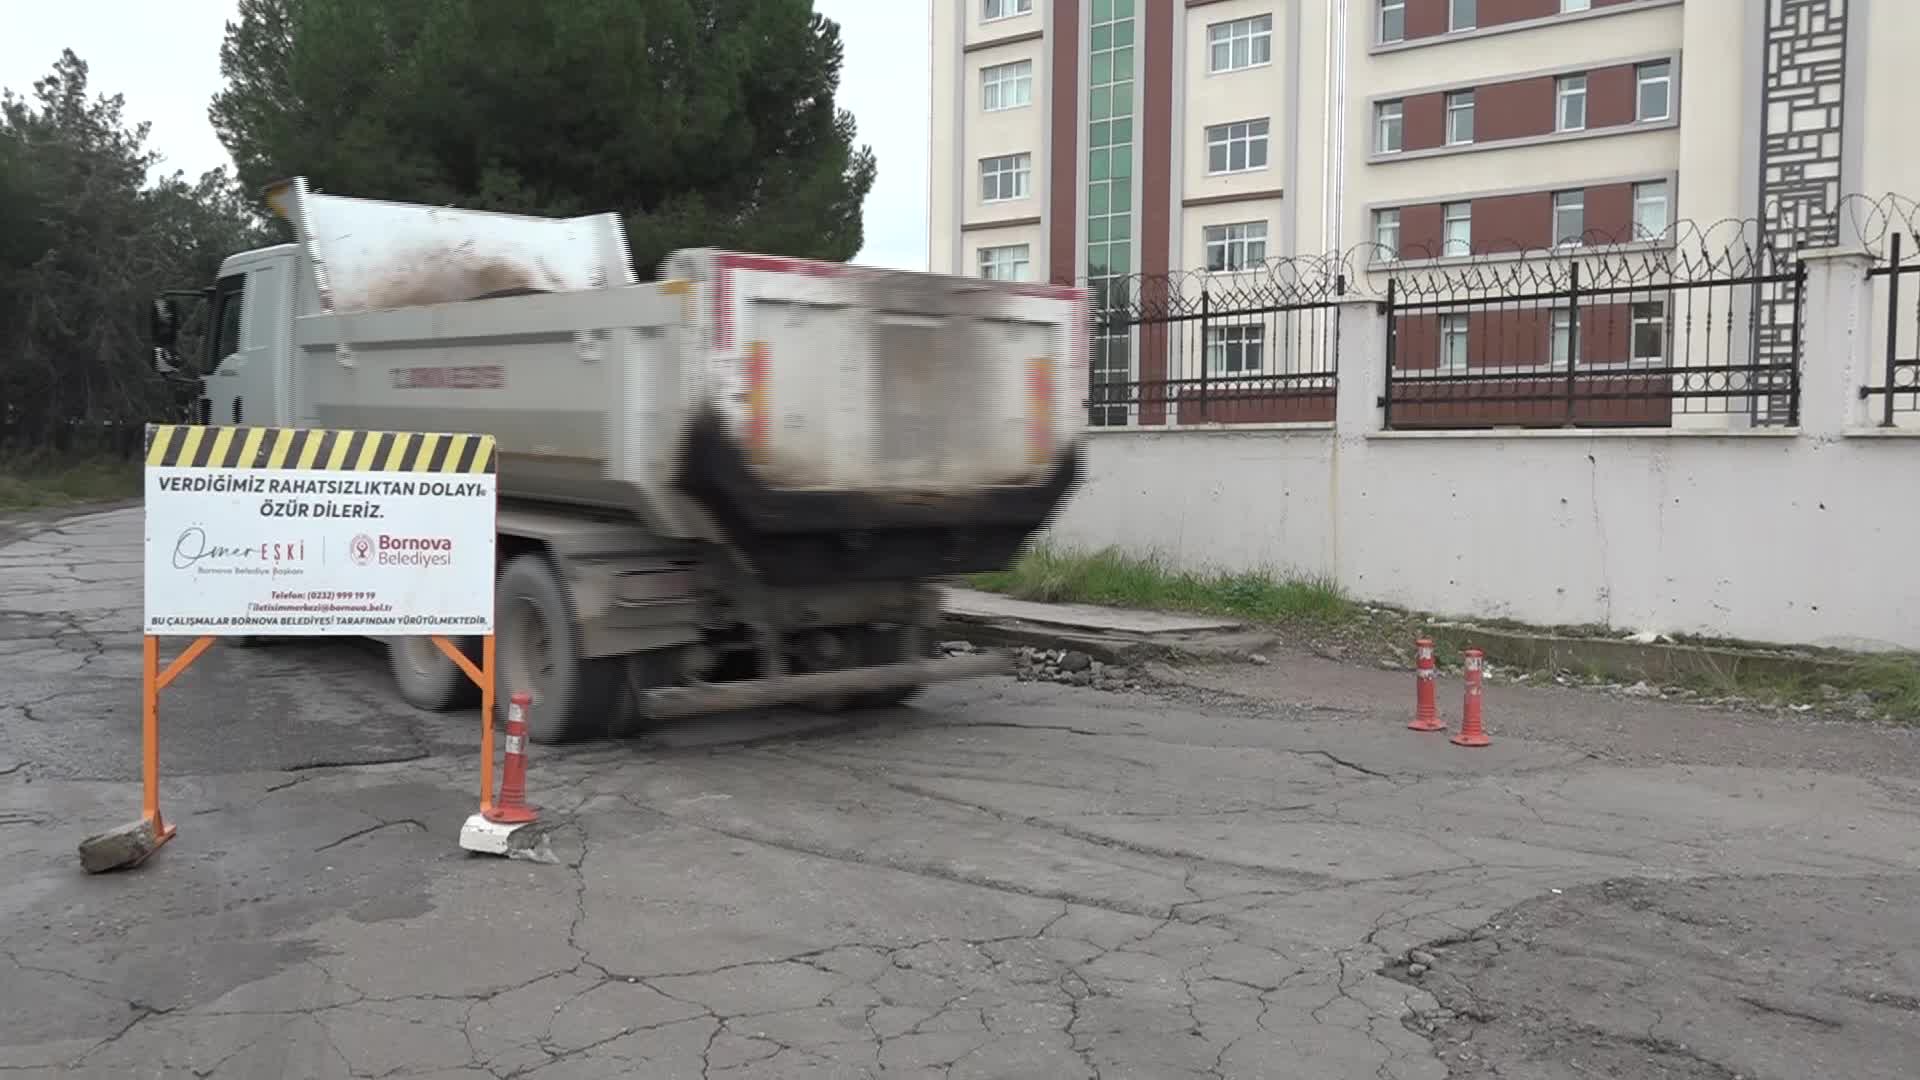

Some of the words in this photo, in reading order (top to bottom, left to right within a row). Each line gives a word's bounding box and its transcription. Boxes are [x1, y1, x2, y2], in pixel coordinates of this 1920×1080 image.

[159, 474, 265, 493] VERDİĞİMİZ
[268, 478, 415, 496] RAHATSIZLIKTAN
[260, 499, 309, 517] ÖZÜR
[312, 501, 385, 518] DİLERİZ.
[378, 535, 452, 550] Bornova
[378, 552, 451, 568] Belediyesi
[271, 591, 305, 600] Telefon:
[336, 592, 353, 600] 999
[151, 617, 165, 626] BU
[166, 616, 229, 627] ÇALIŞMALAR
[231, 616, 278, 626] BORNOVA
[336, 617, 396, 626] TARAFINDAN
